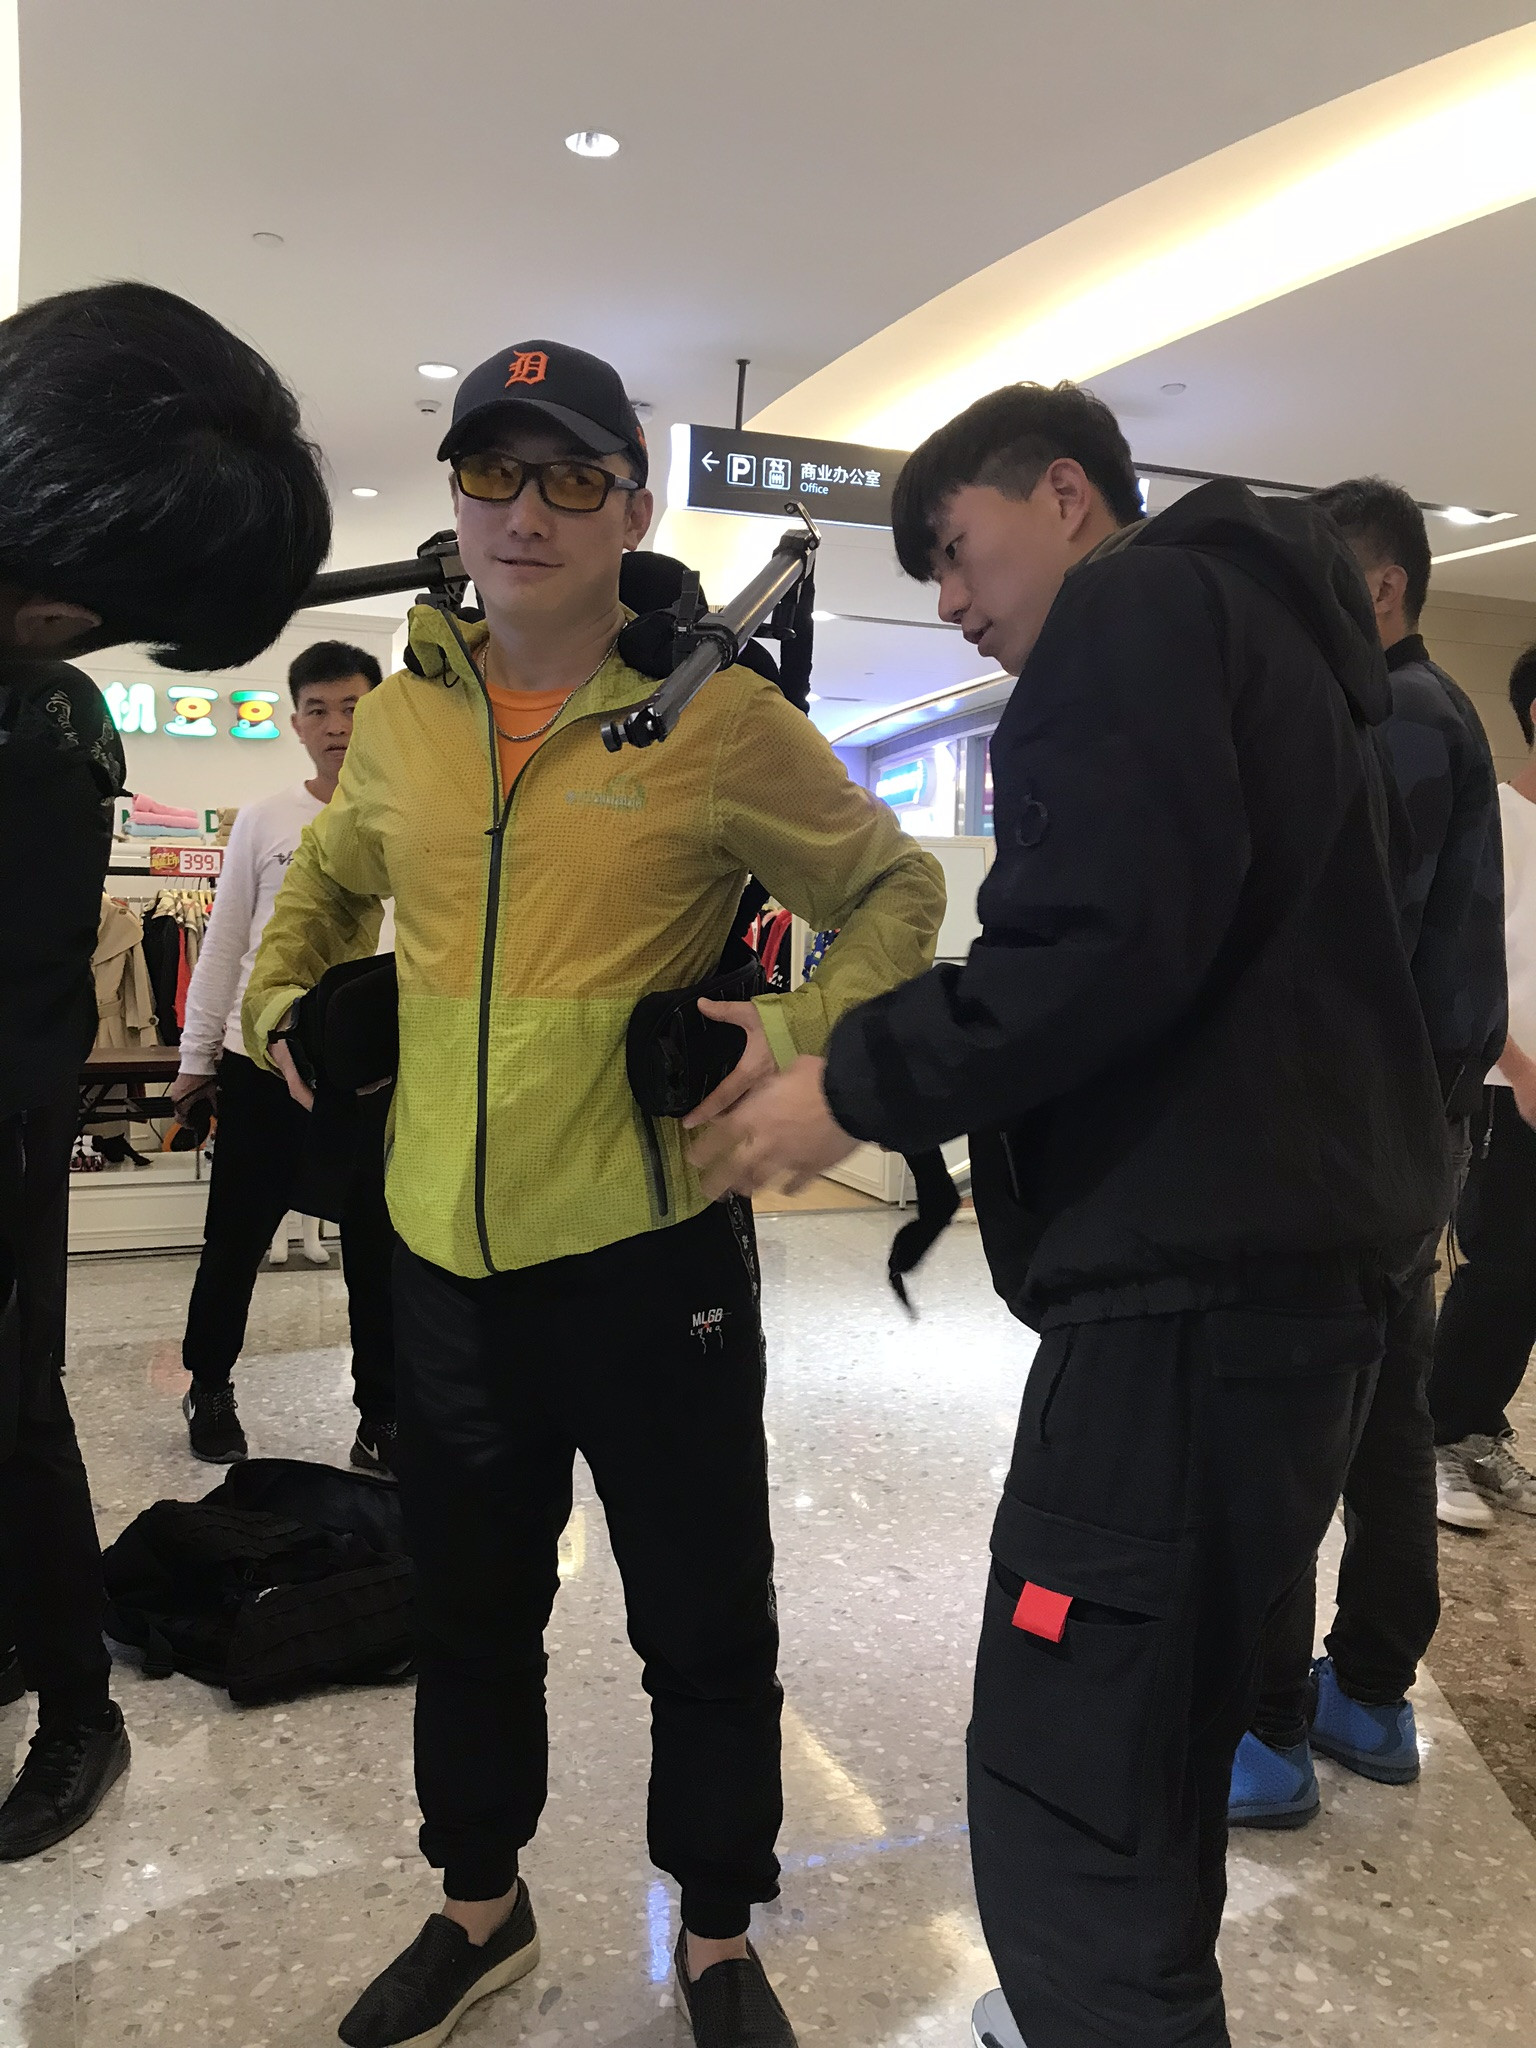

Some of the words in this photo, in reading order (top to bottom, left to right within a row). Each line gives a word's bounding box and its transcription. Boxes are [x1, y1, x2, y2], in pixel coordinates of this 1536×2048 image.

[504, 350, 550, 389] D
[732, 456, 751, 482] P
[800, 462, 881, 488] 商业办公室
[800, 482, 829, 494] Office
[183, 853, 214, 871] 399
[692, 1308, 724, 1328] MLGB
